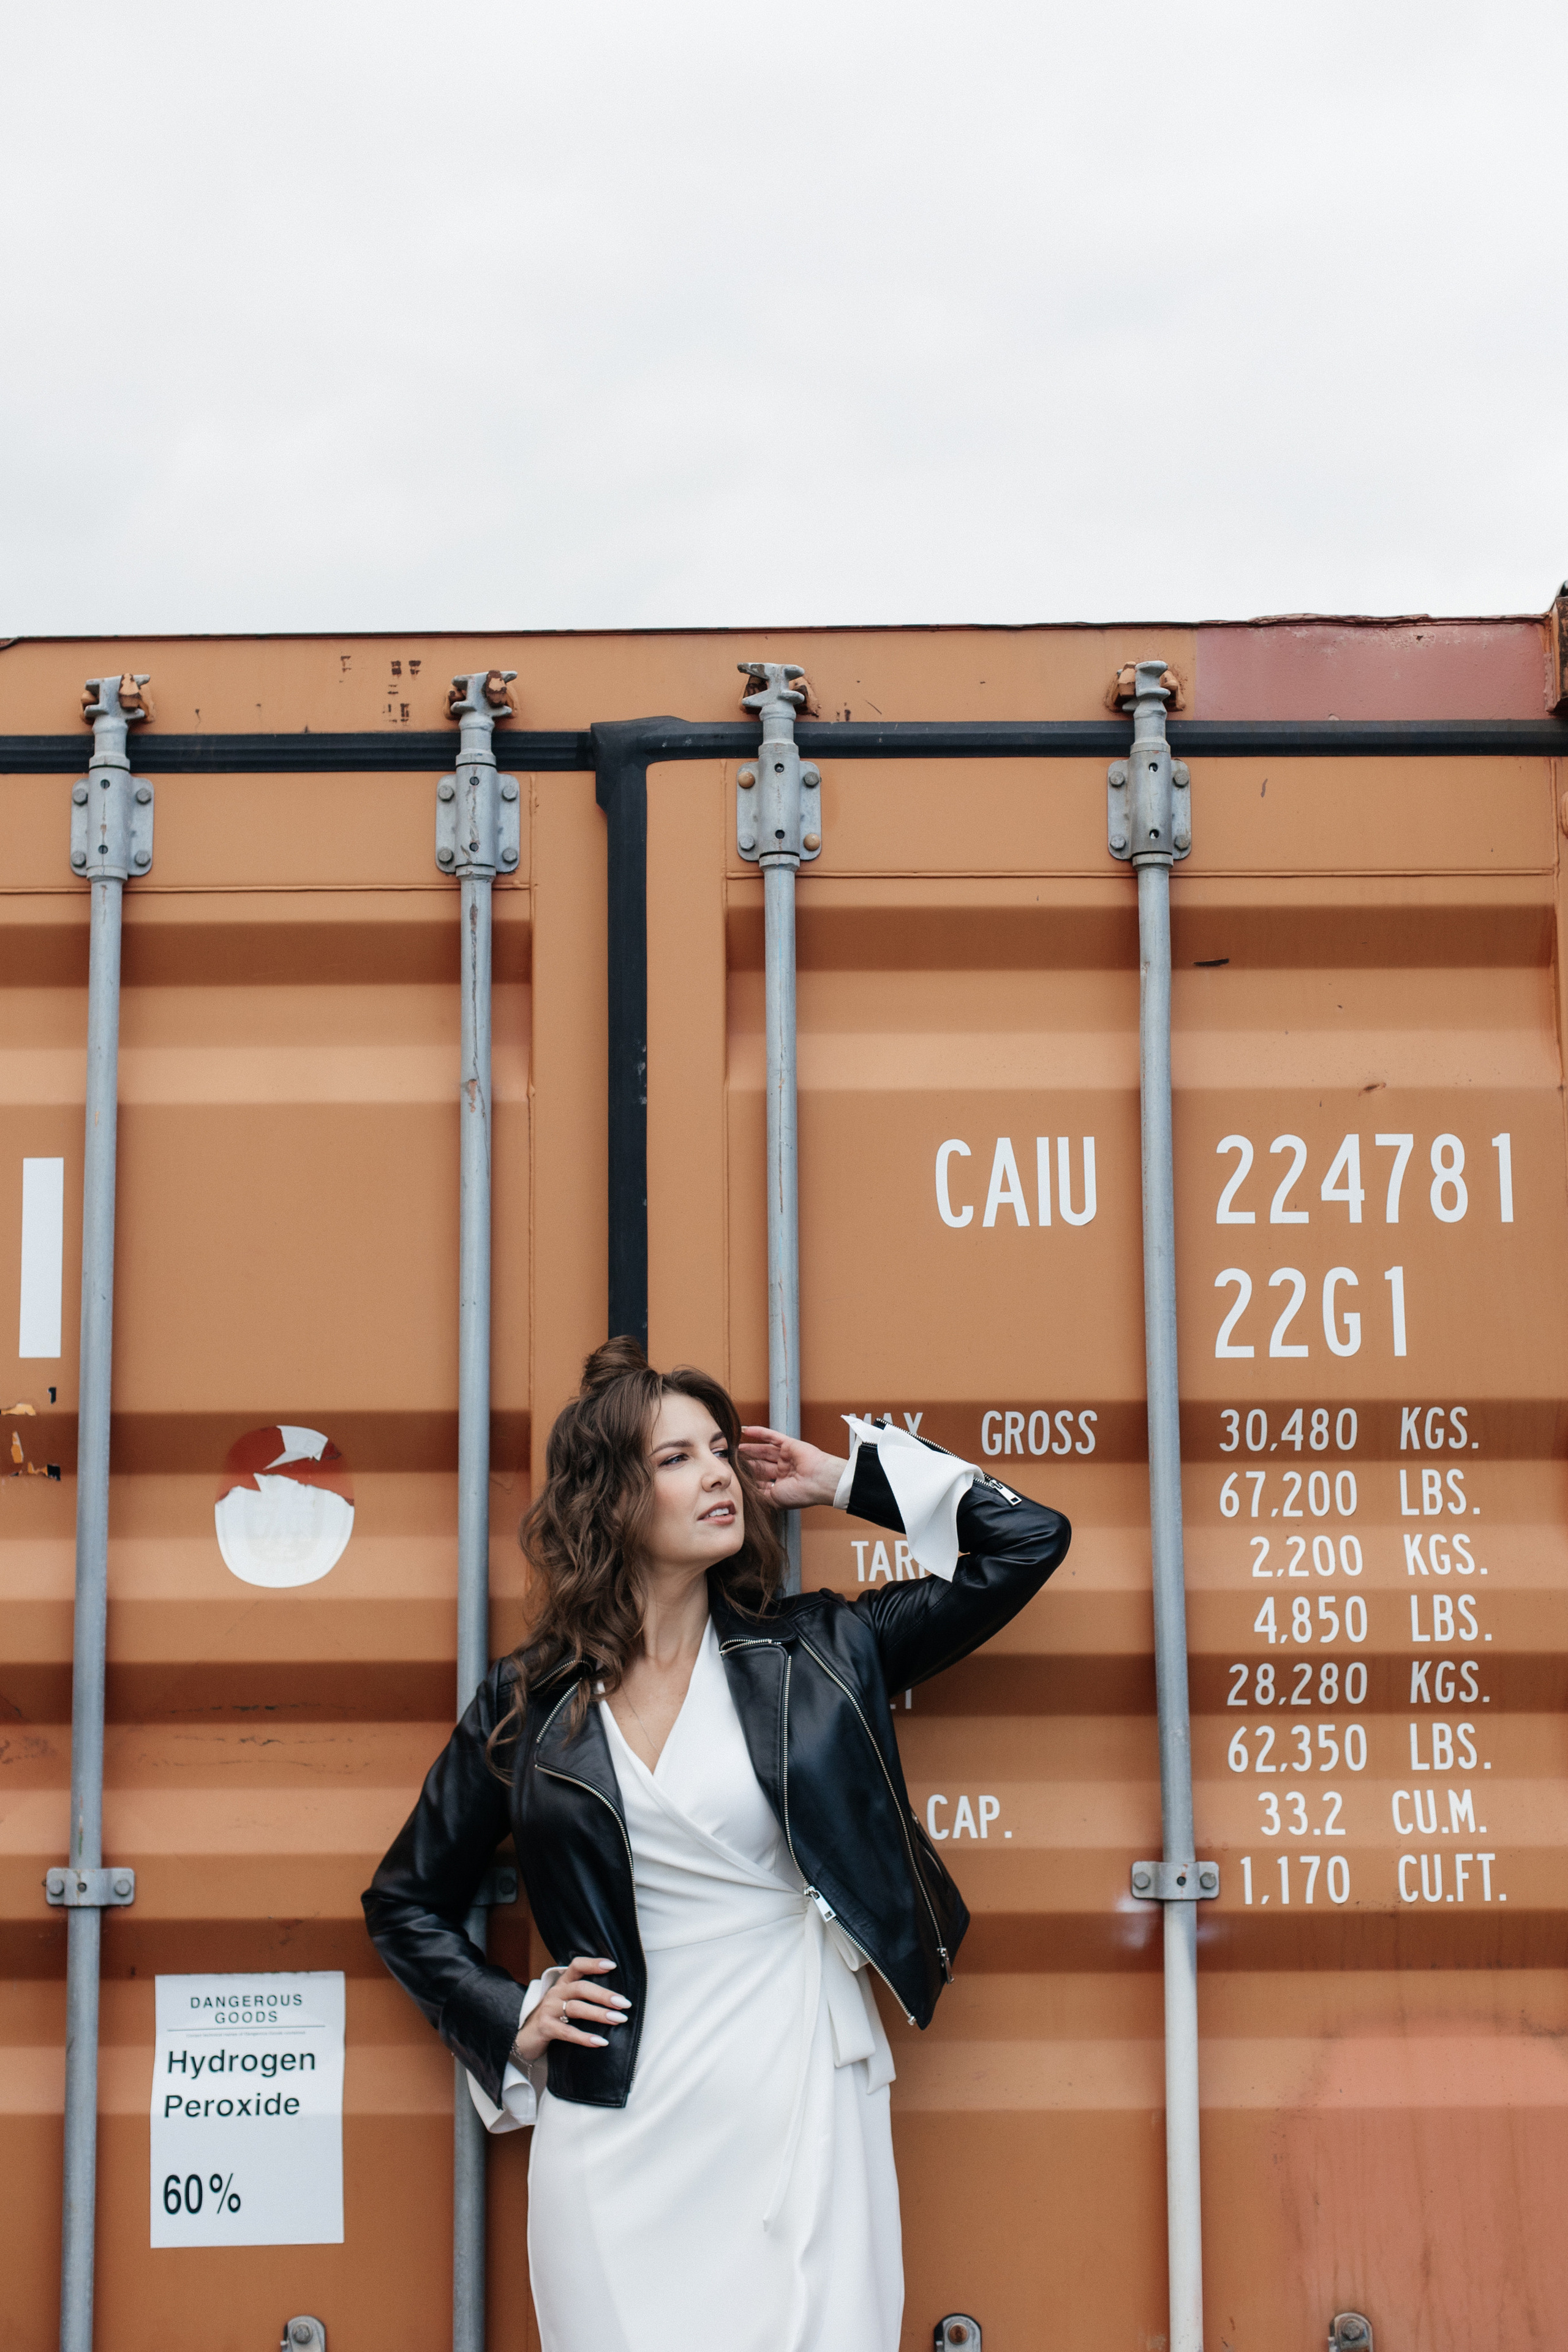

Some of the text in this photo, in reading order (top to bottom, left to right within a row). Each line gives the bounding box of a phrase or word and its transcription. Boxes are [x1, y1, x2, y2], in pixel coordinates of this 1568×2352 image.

[935, 1133, 1515, 1229] CAIU 224781
[1214, 1266, 1408, 1359] 22G1
[981, 1410, 1098, 1457] GROSS
[1219, 1408, 1359, 1452] 30,480
[1400, 1407, 1480, 1450] KGS.
[1219, 1469, 1481, 1518] 67,200 LBS.
[850, 1534, 1488, 1582] TAR 2,200 KGS.
[1254, 1594, 1493, 1645] 4,850 LBS.
[1227, 1660, 1491, 1706] 28,280 KGS.
[1227, 1723, 1493, 1773] 62,350 LBS.
[927, 1789, 1488, 1841] CAP. 33.2 CU.M.
[1240, 1853, 1507, 1905] 1,170 CU.FT.
[190, 1994, 303, 2009] DANGEROUS
[214, 2010, 279, 2025] GOODS
[167, 2049, 316, 2080] Hydrogen
[164, 2092, 301, 2119] Peroxide
[163, 2173, 242, 2215] 60%
